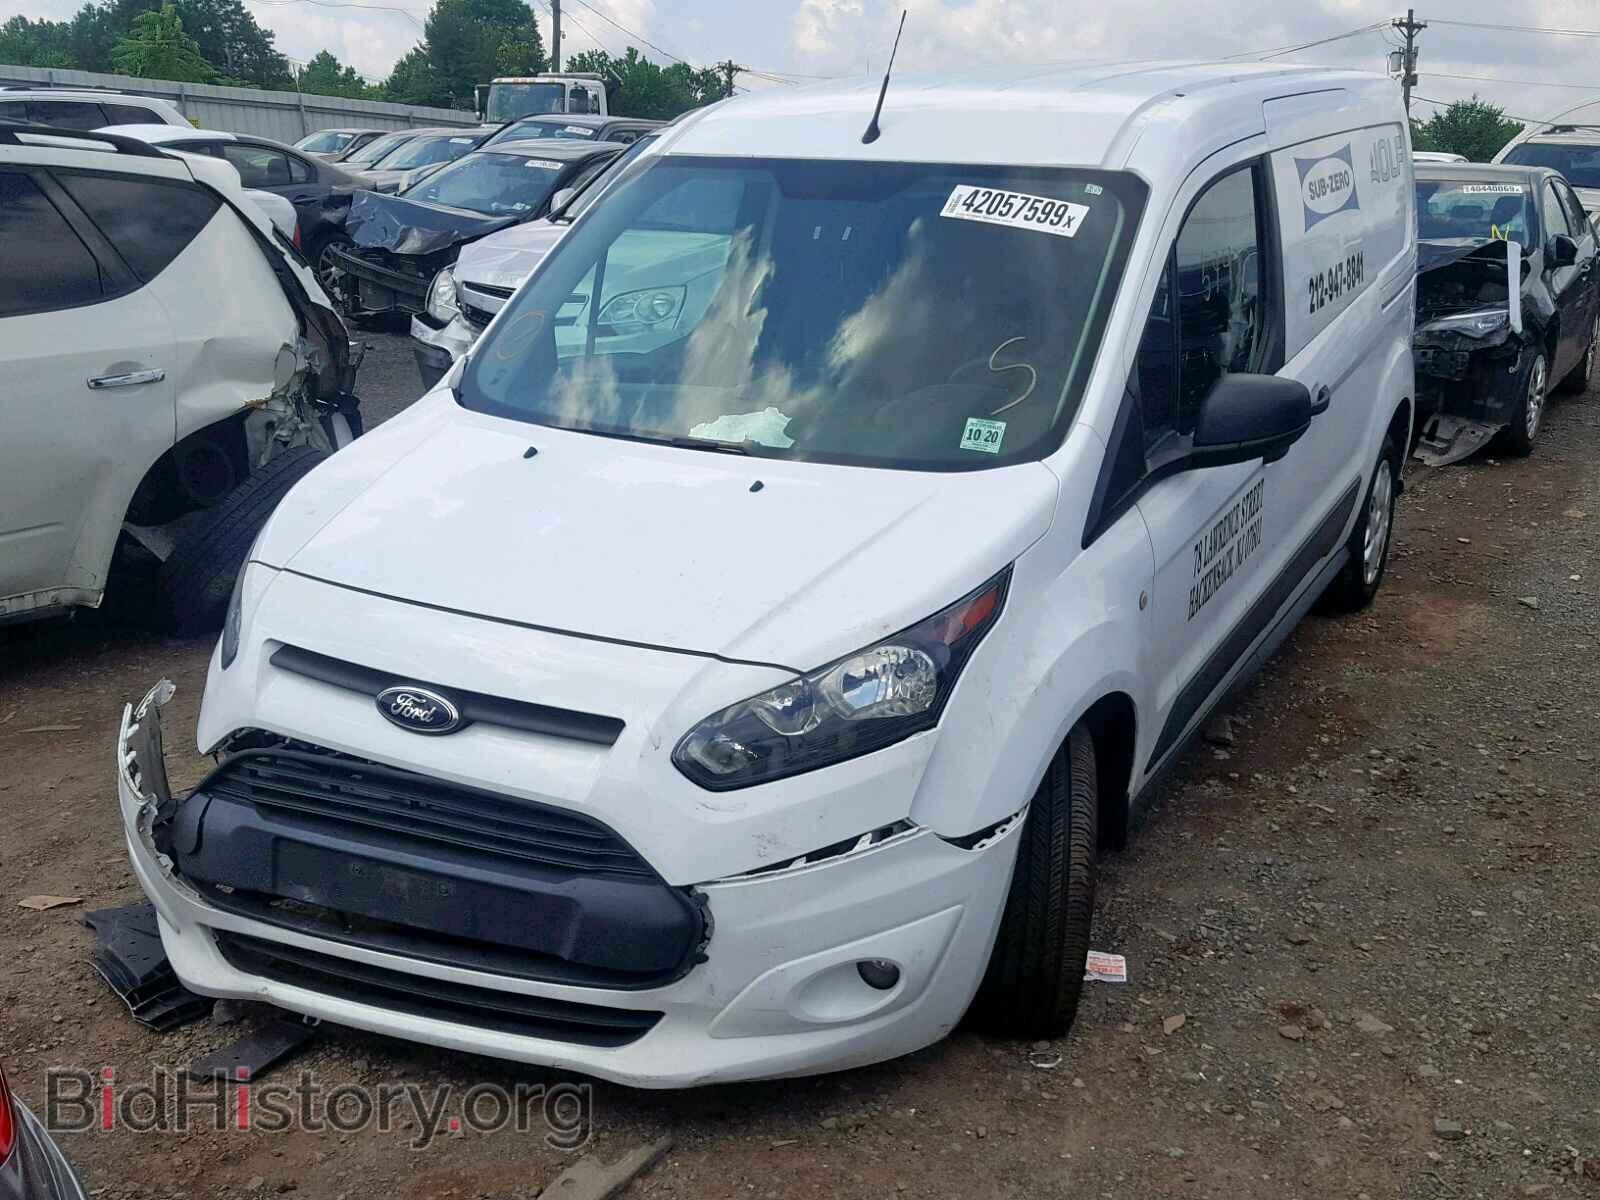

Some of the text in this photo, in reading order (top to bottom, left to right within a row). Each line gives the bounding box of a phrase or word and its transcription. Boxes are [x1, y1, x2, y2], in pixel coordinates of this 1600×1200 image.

[1308, 170, 1350, 200] SUB-ZERO
[1309, 251, 1364, 314] 212-947-8841
[966, 428, 999, 443] 10 20
[1193, 540, 1202, 578] 78
[1240, 478, 1264, 528] STREET
[391, 693, 437, 722] Ford
